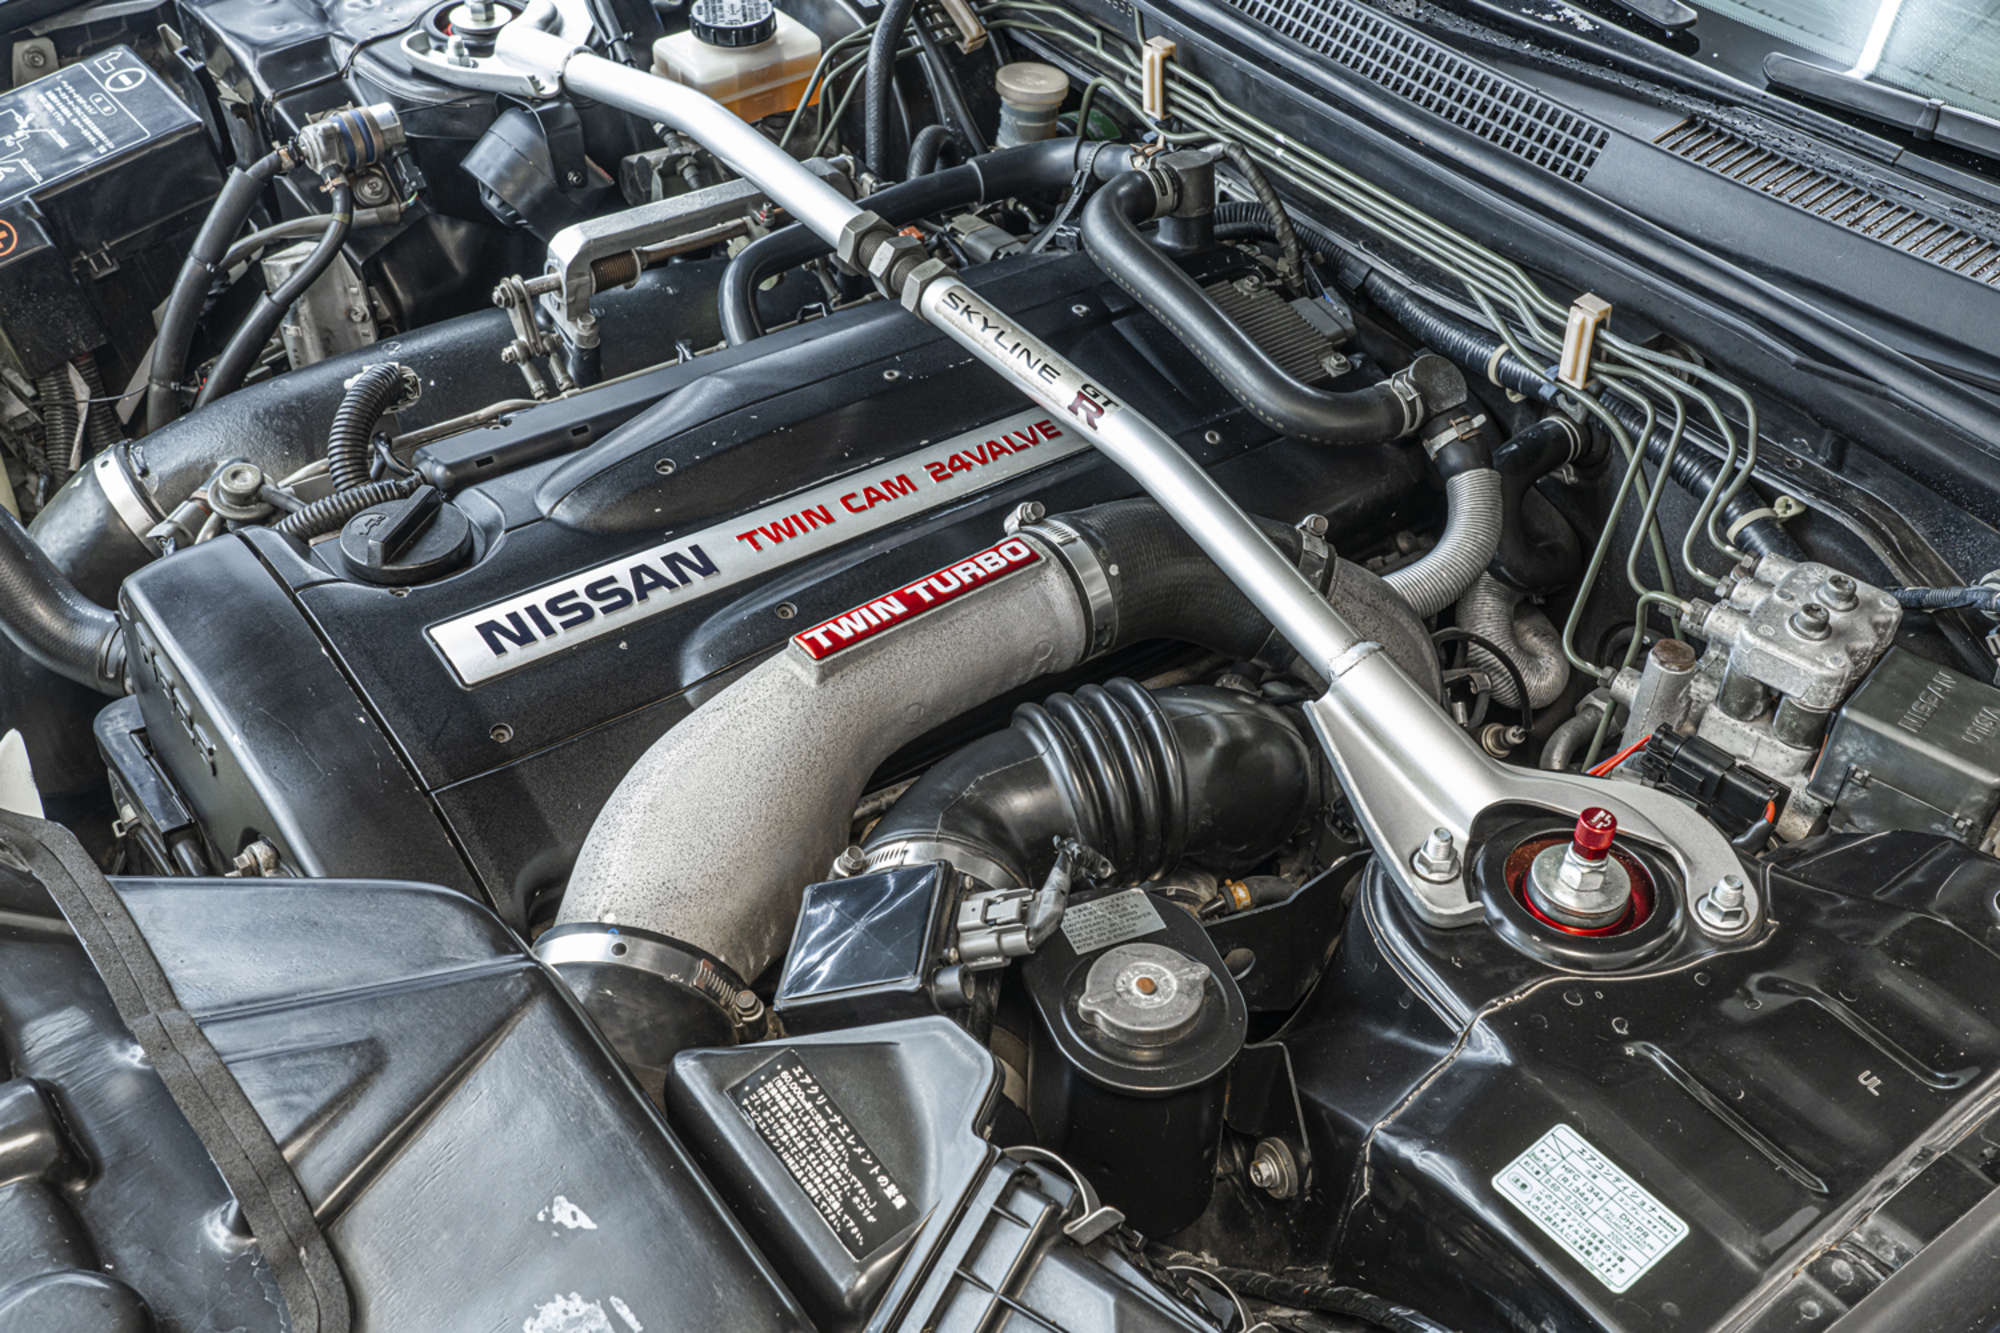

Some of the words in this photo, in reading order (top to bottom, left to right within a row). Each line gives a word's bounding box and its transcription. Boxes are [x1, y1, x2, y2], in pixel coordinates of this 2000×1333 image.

[942, 291, 1061, 384] SKYLINE
[475, 544, 720, 657] NISSAN
[736, 504, 836, 552] TWIN
[839, 473, 918, 514] CAM
[923, 419, 1063, 483] 24VALVE
[803, 595, 907, 650] TWIN
[904, 539, 1032, 604] TURBO
[1897, 671, 1957, 733] NISSAN
[790, 1063, 907, 1210] エアクリーナエレメントの整備
